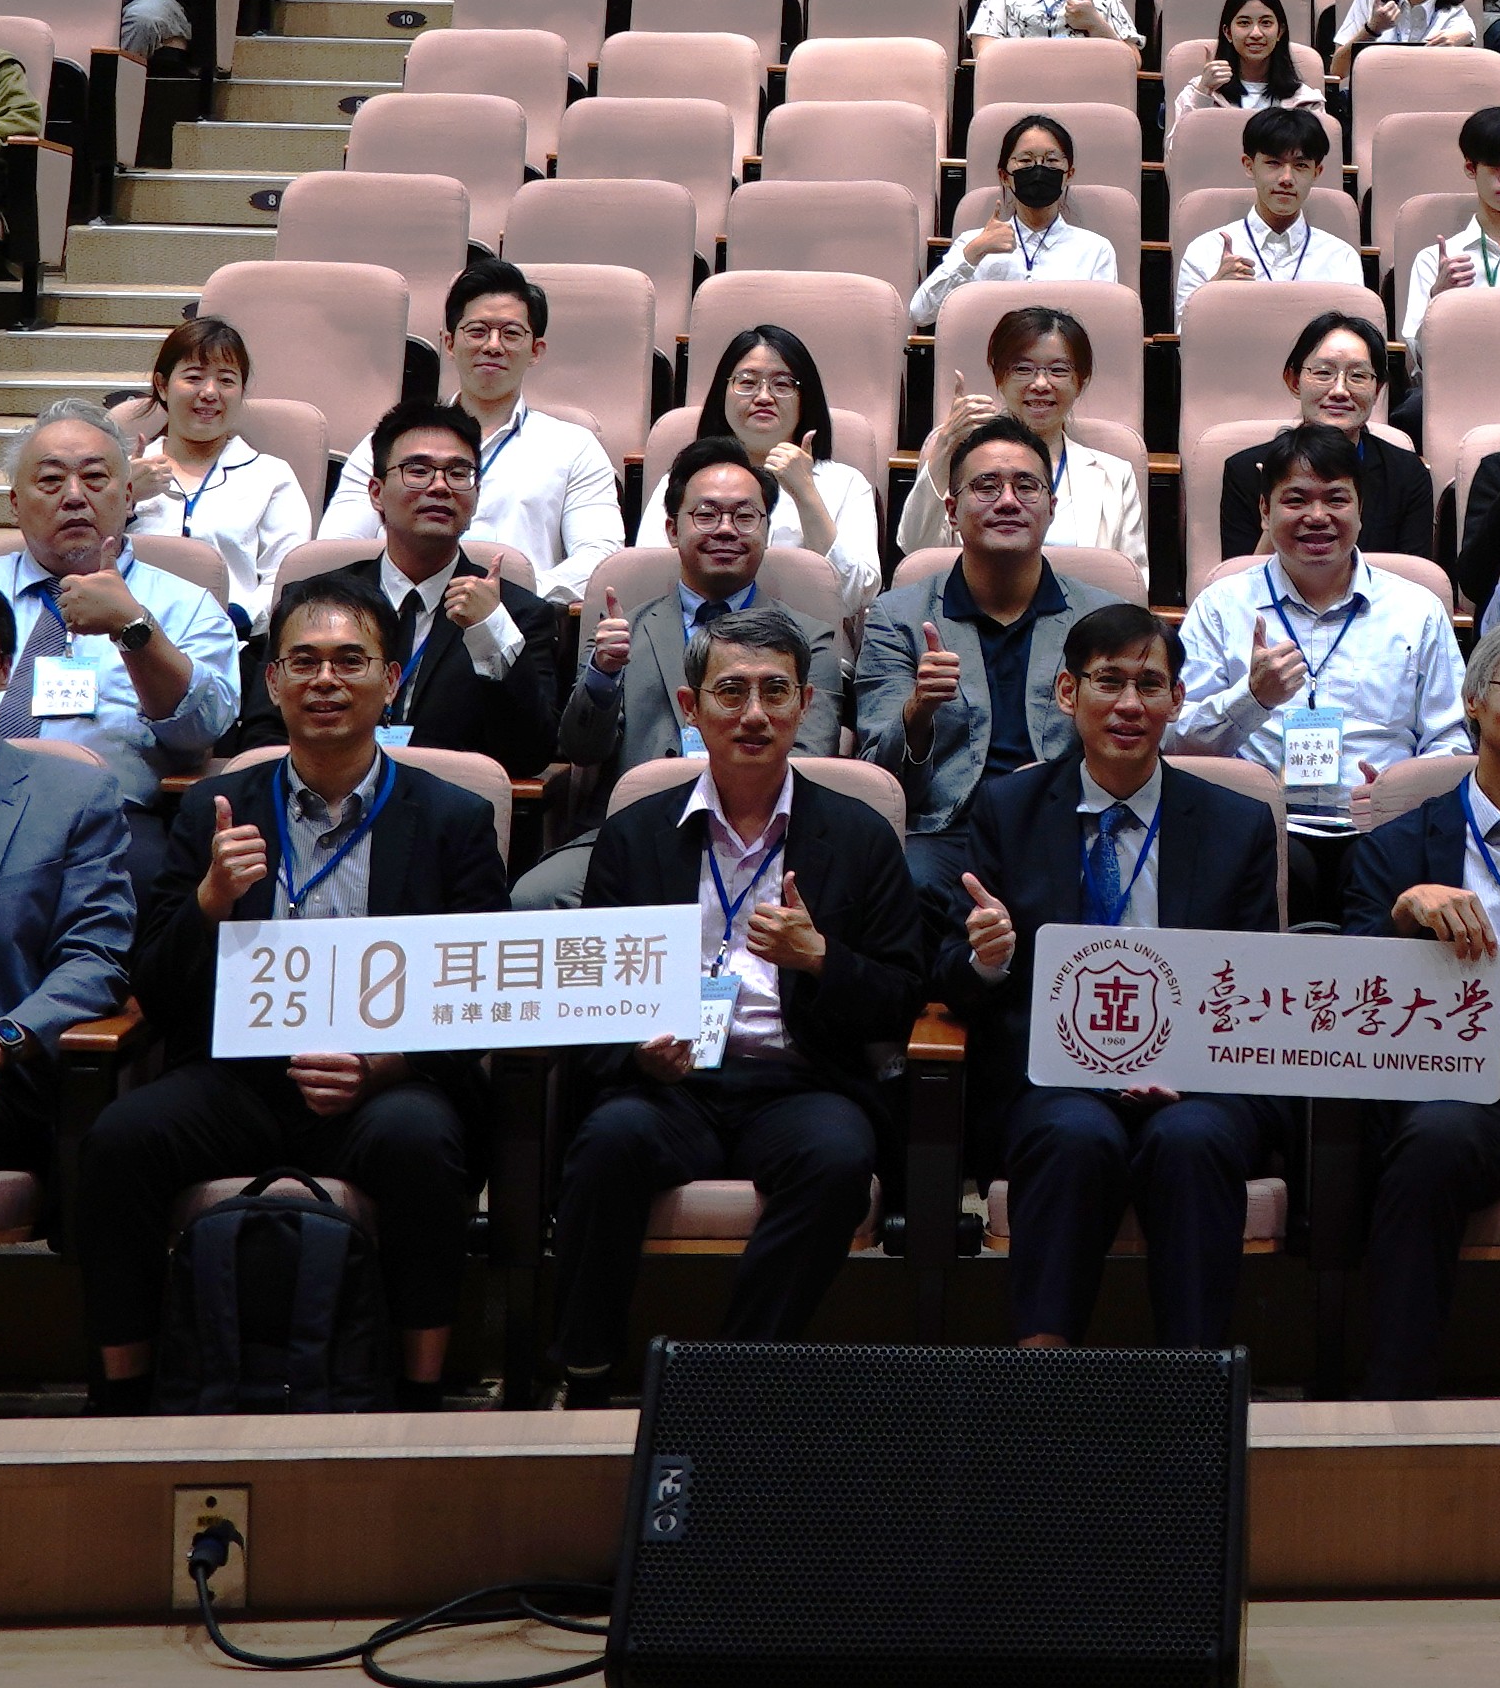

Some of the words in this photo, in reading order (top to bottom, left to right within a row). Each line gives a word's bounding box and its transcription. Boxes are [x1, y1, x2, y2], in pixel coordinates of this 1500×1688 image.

[400, 14, 414, 25] 10
[268, 193, 277, 206] 8
[251, 946, 311, 983] 20
[432, 933, 668, 993] 耳目醫新
[1050, 961, 1074, 1002] TAIPEI
[1073, 938, 1131, 963] MEDICAL
[1134, 942, 1182, 1007] UNIVERSITY
[248, 991, 308, 1028] 25
[432, 1001, 541, 1025] 精準健康
[557, 998, 661, 1019] DemoDay
[1200, 959, 1493, 1042] 臺北醫學大學
[1207, 1045, 1276, 1065] TAIPEI
[1281, 1048, 1367, 1068] MEDICAL
[1373, 1051, 1486, 1075] UNIVERSITY
[653, 1465, 684, 1533] NEXO
